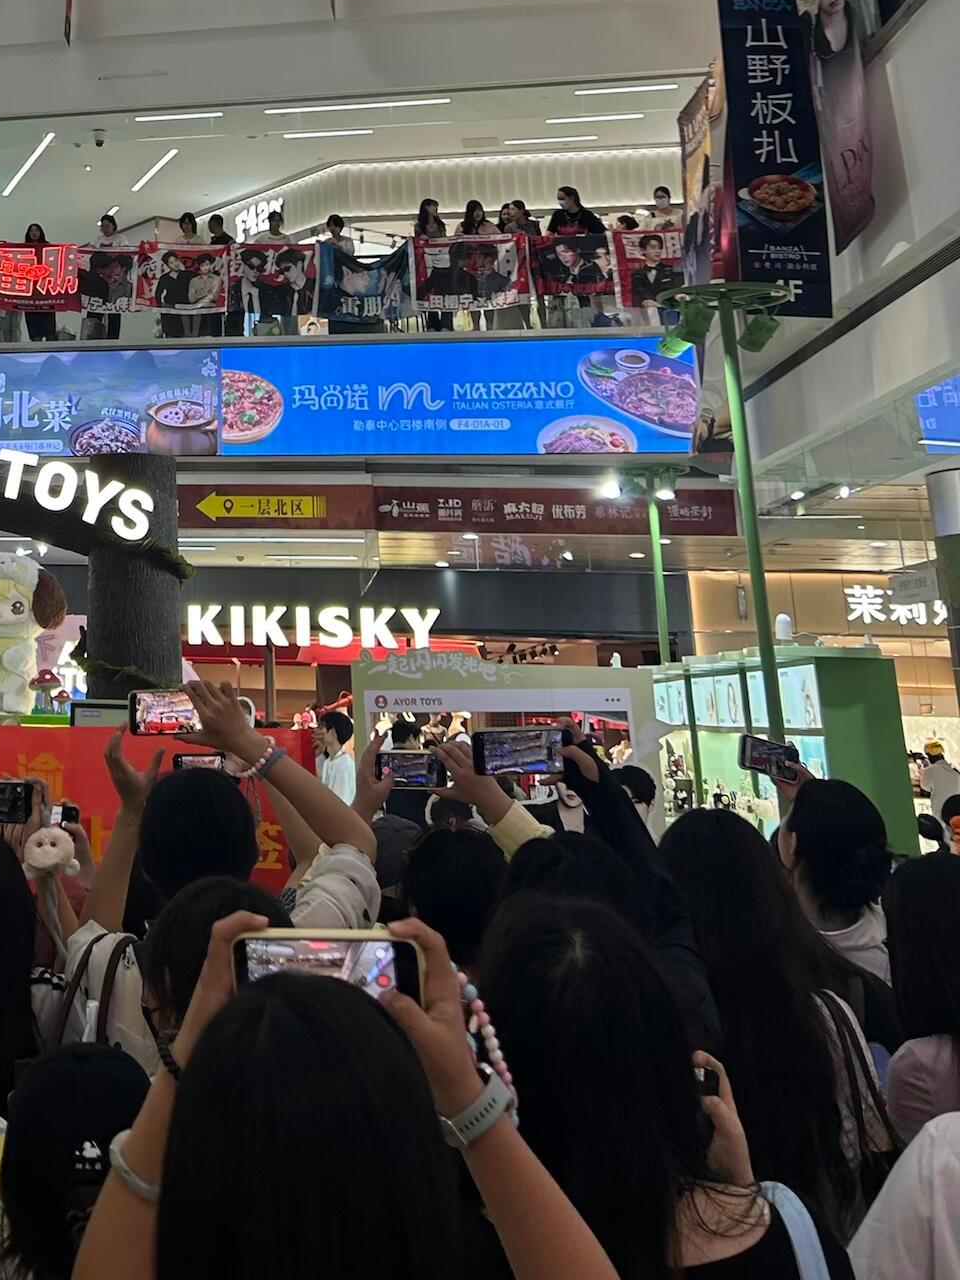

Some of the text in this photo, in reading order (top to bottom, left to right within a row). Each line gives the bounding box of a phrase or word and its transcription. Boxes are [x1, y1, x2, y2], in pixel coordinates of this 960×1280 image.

[292, 383, 369, 411] 玛尚诺
[452, 380, 575, 400] MARZANO
[452, 401, 489, 410] ITALIAN
[492, 401, 533, 410] OSTERIA
[240, 499, 304, 517] 一层北区
[552, 504, 586, 519] 优布劳
[187, 604, 441, 649] KIKISKY
[368, 649, 497, 681] 一起闪闪发光吧
[393, 696, 443, 706] AYOR TOYS
